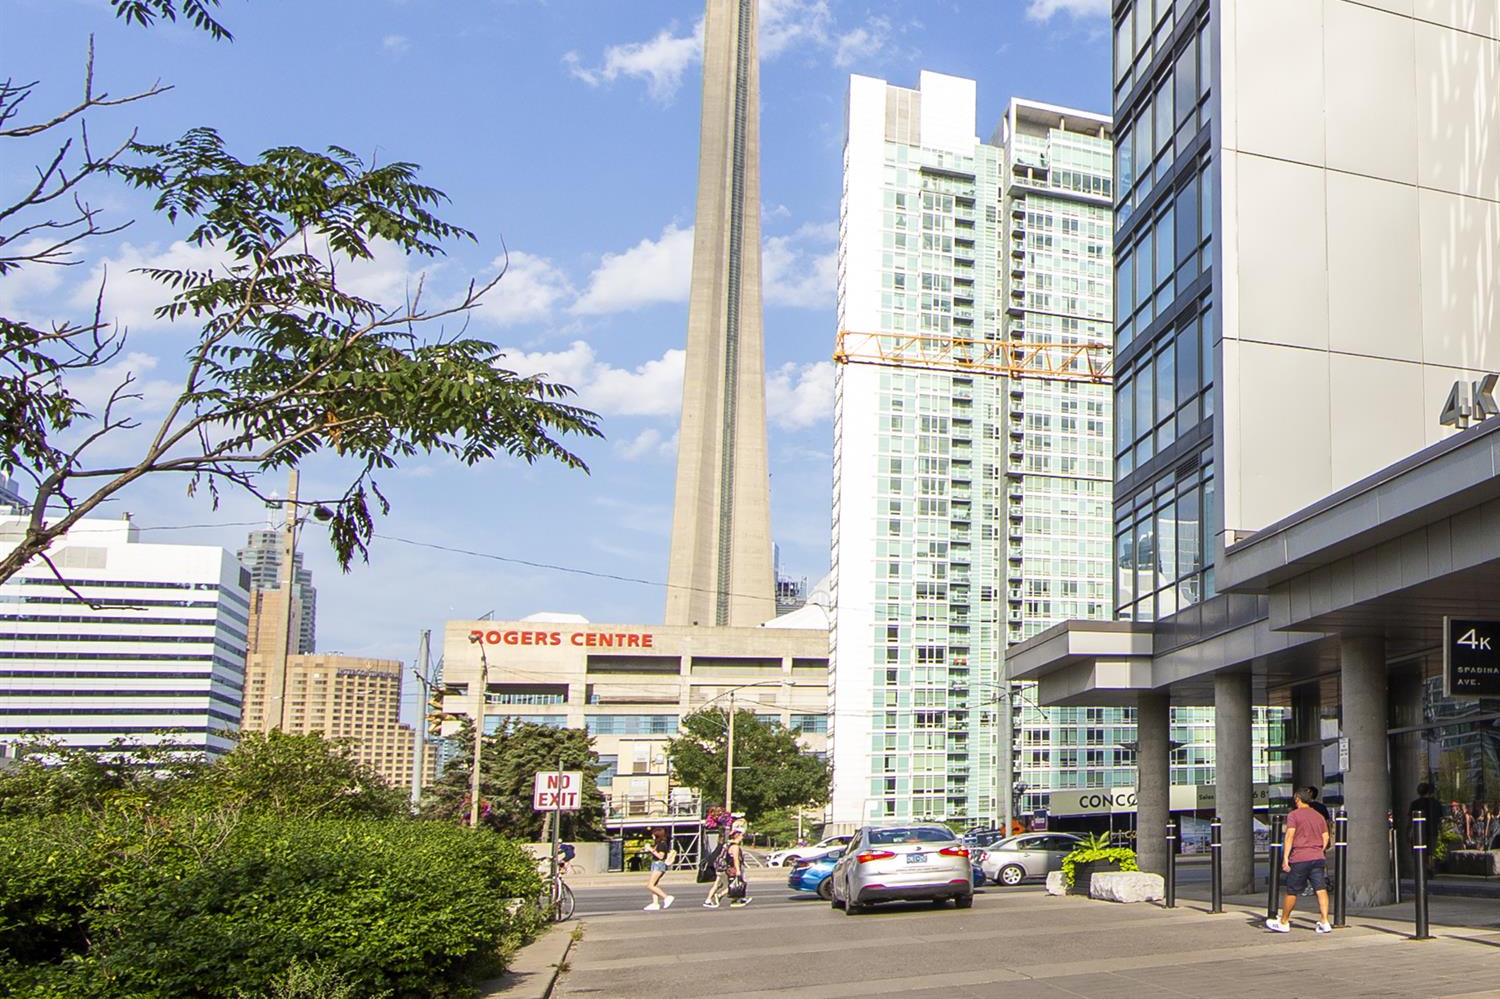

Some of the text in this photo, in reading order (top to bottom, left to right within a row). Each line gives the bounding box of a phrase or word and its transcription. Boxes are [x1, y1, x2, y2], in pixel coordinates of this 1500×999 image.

[1440, 374, 1499, 429] 4K
[570, 632, 653, 647] CENTRE
[1457, 628, 1492, 650] 4K
[1457, 666, 1500, 674] SPADINA
[547, 775, 570, 789] NO
[538, 792, 577, 806] EXIT
[1079, 793, 1138, 808] CONCO
